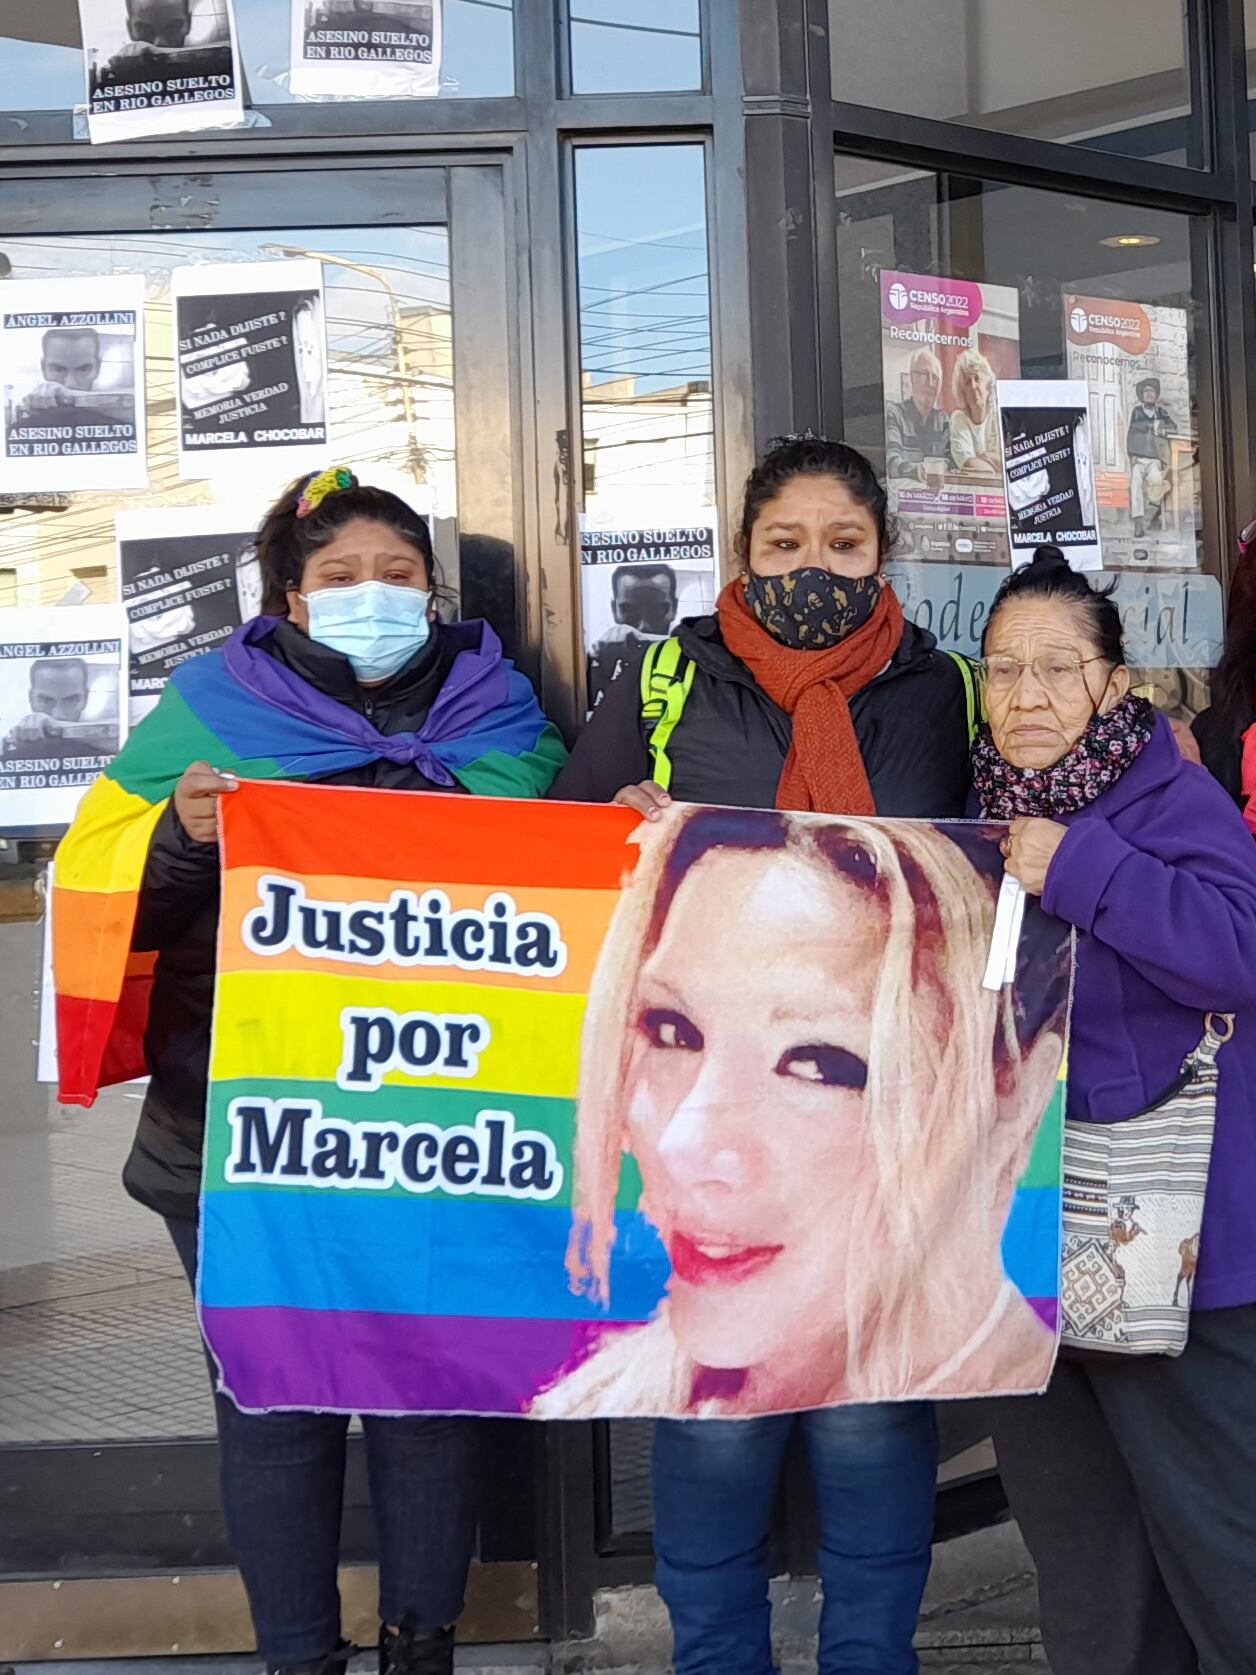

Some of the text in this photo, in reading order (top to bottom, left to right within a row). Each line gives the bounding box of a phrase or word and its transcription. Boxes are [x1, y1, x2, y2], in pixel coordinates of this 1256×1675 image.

[306, 30, 429, 46] ASESINO SUELTO
[306, 46, 432, 62] EN RIO GALLEGOS
[92, 74, 230, 98] ASESINO SUELTO
[93, 88, 235, 114] EN RIO GALLEGOS
[60, 312, 135, 326] AZZOLLINI
[179, 338, 192, 351] SI
[193, 330, 230, 349] NADA
[890, 326, 974, 348] Reconocernos
[186, 350, 240, 374] COMPLICE
[240, 338, 280, 359] FUISTE
[1072, 351, 1140, 370] Reconocernos
[194, 382, 288, 420] MEMORIA VERDAD
[218, 402, 268, 425] JUSTICIA
[8, 424, 133, 441] ASESINO SUELTO
[184, 428, 325, 445] MARCELA CHOCOBAR
[9, 439, 137, 456] EN RIO GALLEGOS
[581, 528, 707, 546] SESINO SUELTO
[1014, 530, 1096, 544] MARCELA CHOCOBAR
[596, 549, 624, 564] RIO
[626, 544, 712, 562] GALLEGOS
[122, 584, 136, 596] SI
[136, 574, 173, 593] NADA
[130, 594, 185, 618] COMPLICE
[184, 582, 224, 602] FUISTE
[903, 571, 1189, 644] ode cial
[48, 641, 119, 656] AZZOLLINI
[136, 625, 234, 664] MEMORIA VERDAD
[131, 677, 169, 691] MARC
[20, 775, 48, 788] RIO
[48, 771, 104, 786] GALLE
[250, 883, 559, 969] Justicia
[346, 1015, 481, 1082] por
[233, 1106, 554, 1191] Marcela
